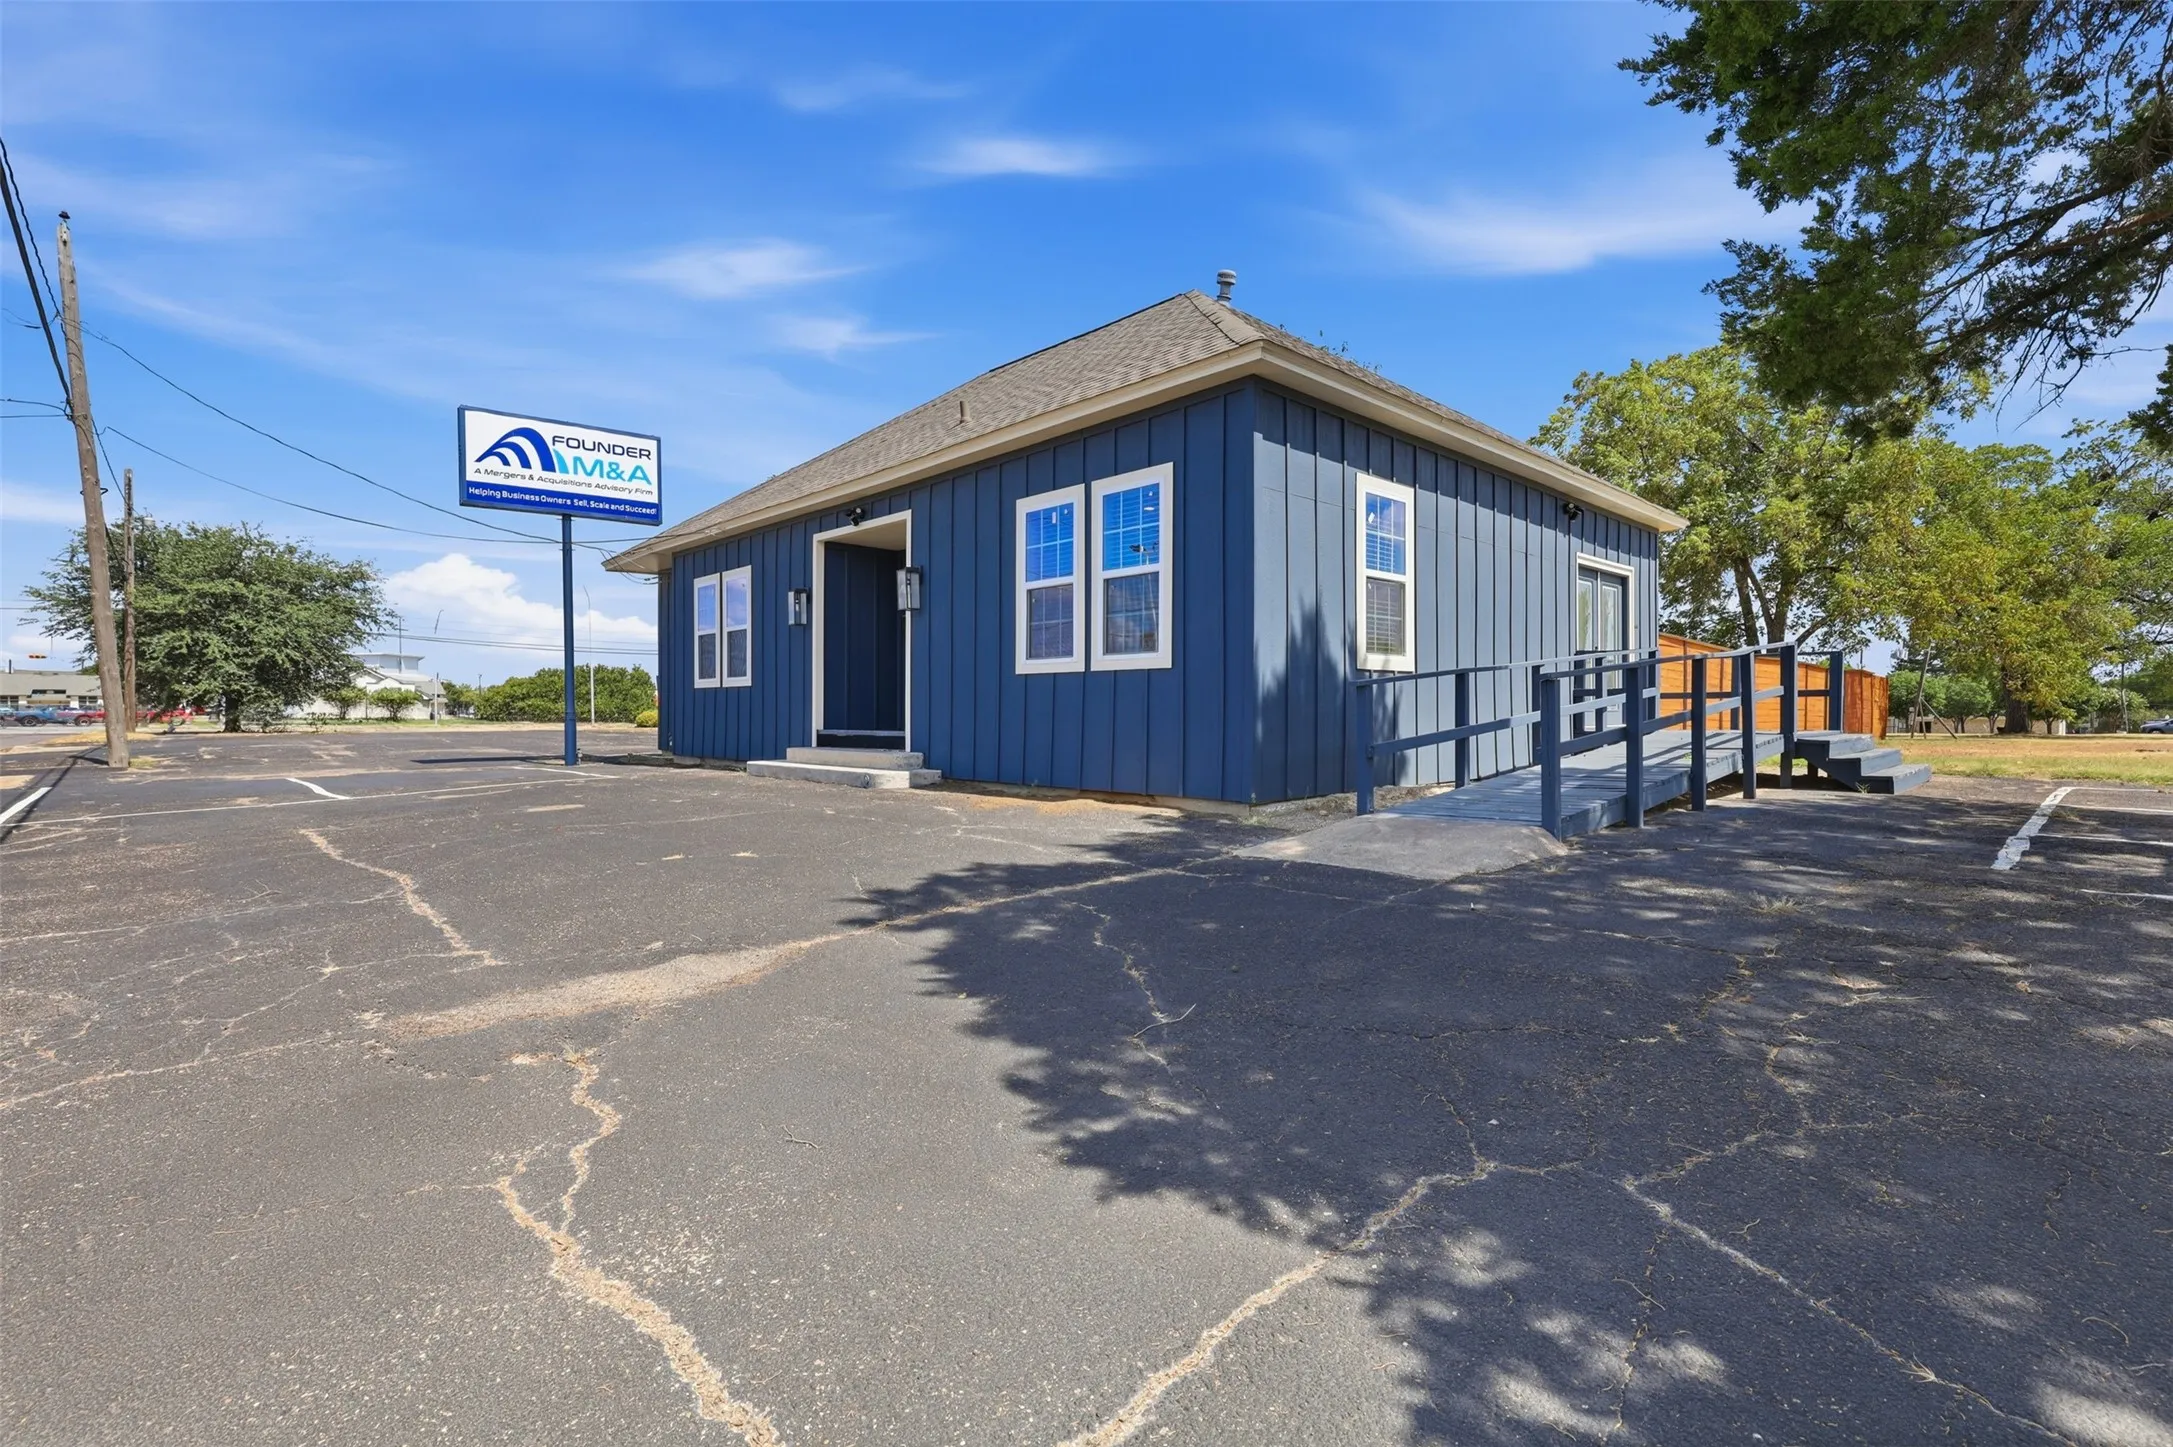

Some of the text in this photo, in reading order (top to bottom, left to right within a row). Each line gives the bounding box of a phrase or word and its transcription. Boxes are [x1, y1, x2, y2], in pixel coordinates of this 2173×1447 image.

[552, 436, 651, 460] FOUNDER
[484, 469, 526, 480] Mergers
[537, 476, 592, 488] Acquisitions
[594, 482, 633, 495] Advisory
[573, 456, 652, 485] M&A
[469, 487, 500, 499] Helping
[502, 491, 540, 501] Business
[541, 496, 571, 505] Owners
[625, 505, 656, 515] Succeed!
